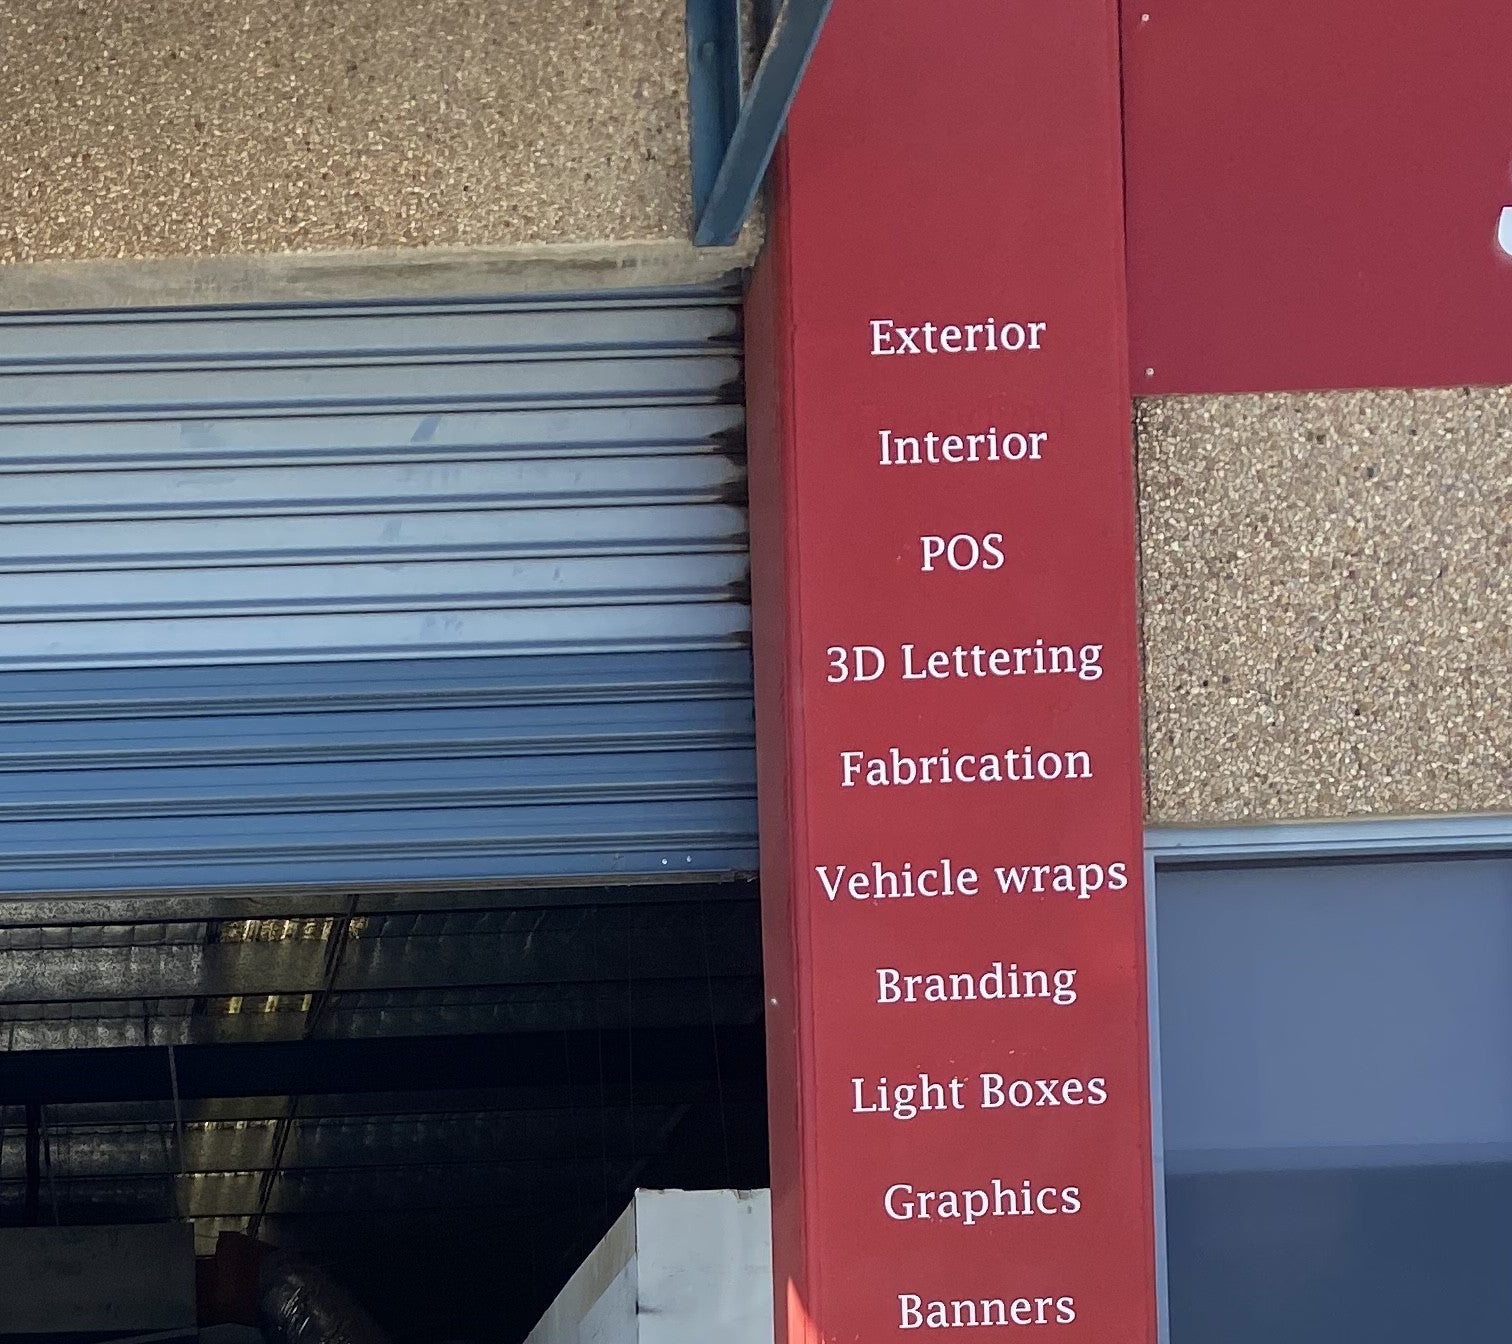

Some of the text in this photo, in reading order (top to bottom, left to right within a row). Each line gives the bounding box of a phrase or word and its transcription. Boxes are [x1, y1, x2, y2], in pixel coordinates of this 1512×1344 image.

[869, 318, 1047, 357] Exterior
[878, 428, 1048, 466] Interior
[920, 533, 1005, 572] POS
[826, 638, 1103, 683] 3D Lettering
[840, 745, 1093, 787] Fabrication
[815, 858, 1128, 901] Vehicle wraps
[875, 961, 1077, 1006] Branding
[851, 1073, 1108, 1120] Light Boxes
[884, 1179, 1081, 1226] Graphics
[897, 1294, 1076, 1329] Banners
